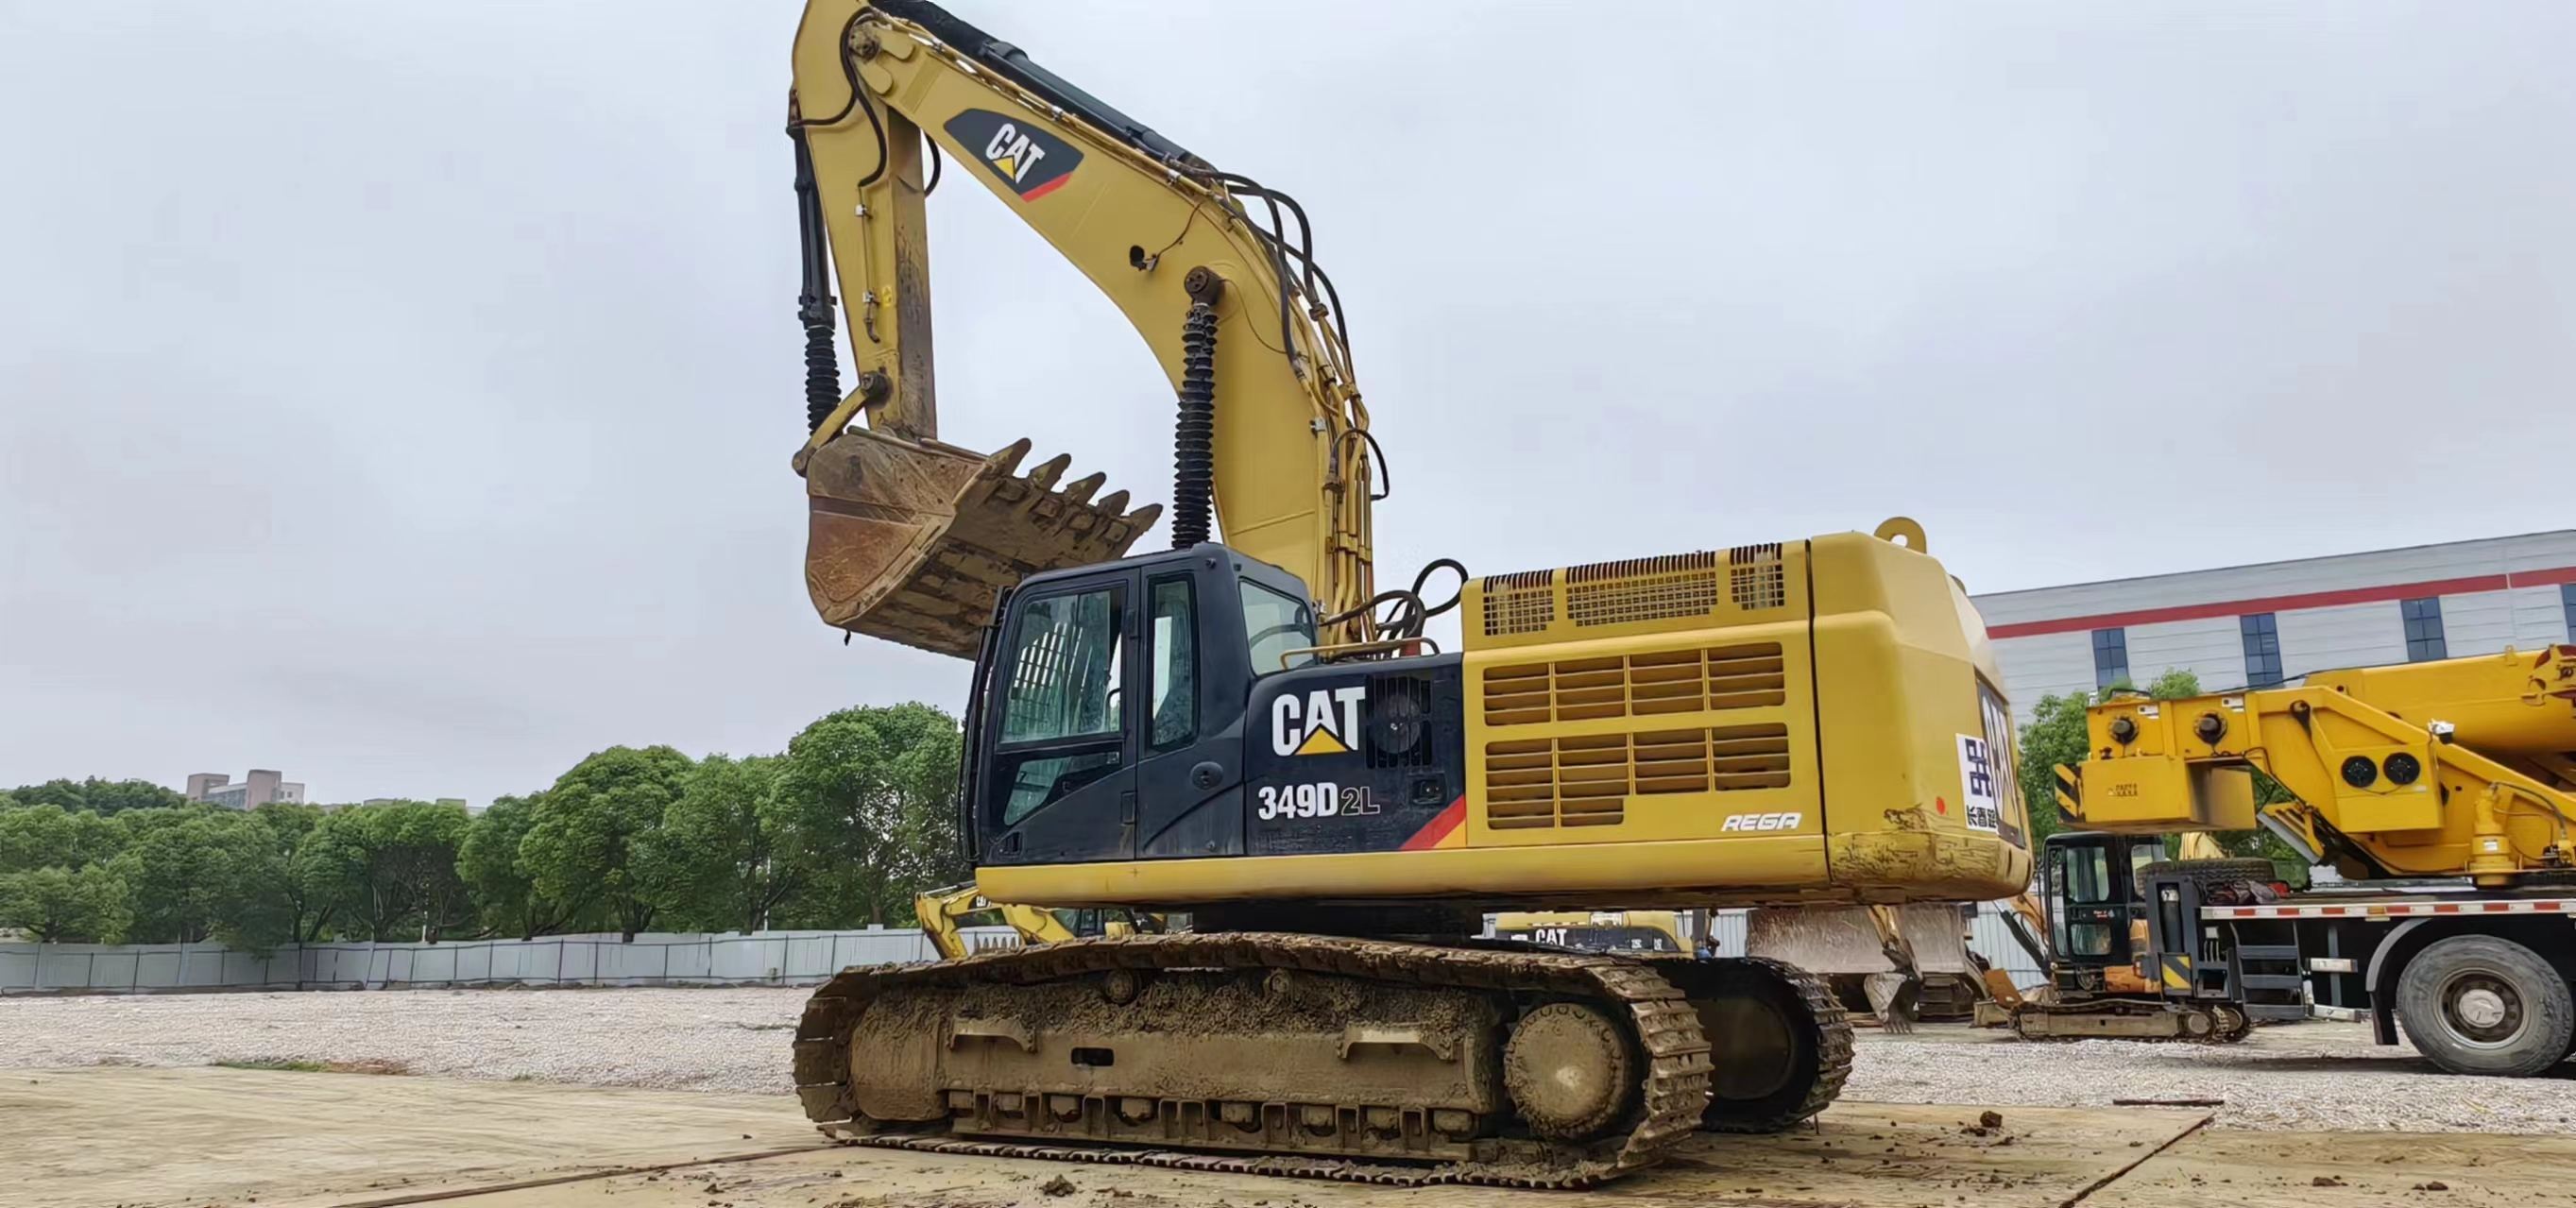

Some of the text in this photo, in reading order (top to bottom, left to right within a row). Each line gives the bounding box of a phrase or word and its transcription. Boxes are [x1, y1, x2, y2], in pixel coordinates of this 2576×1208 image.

[985, 123, 1046, 183] CAT
[1272, 687, 1366, 756] CAT
[1720, 812, 1801, 832] REGA
[1535, 928, 1567, 946] CAT
